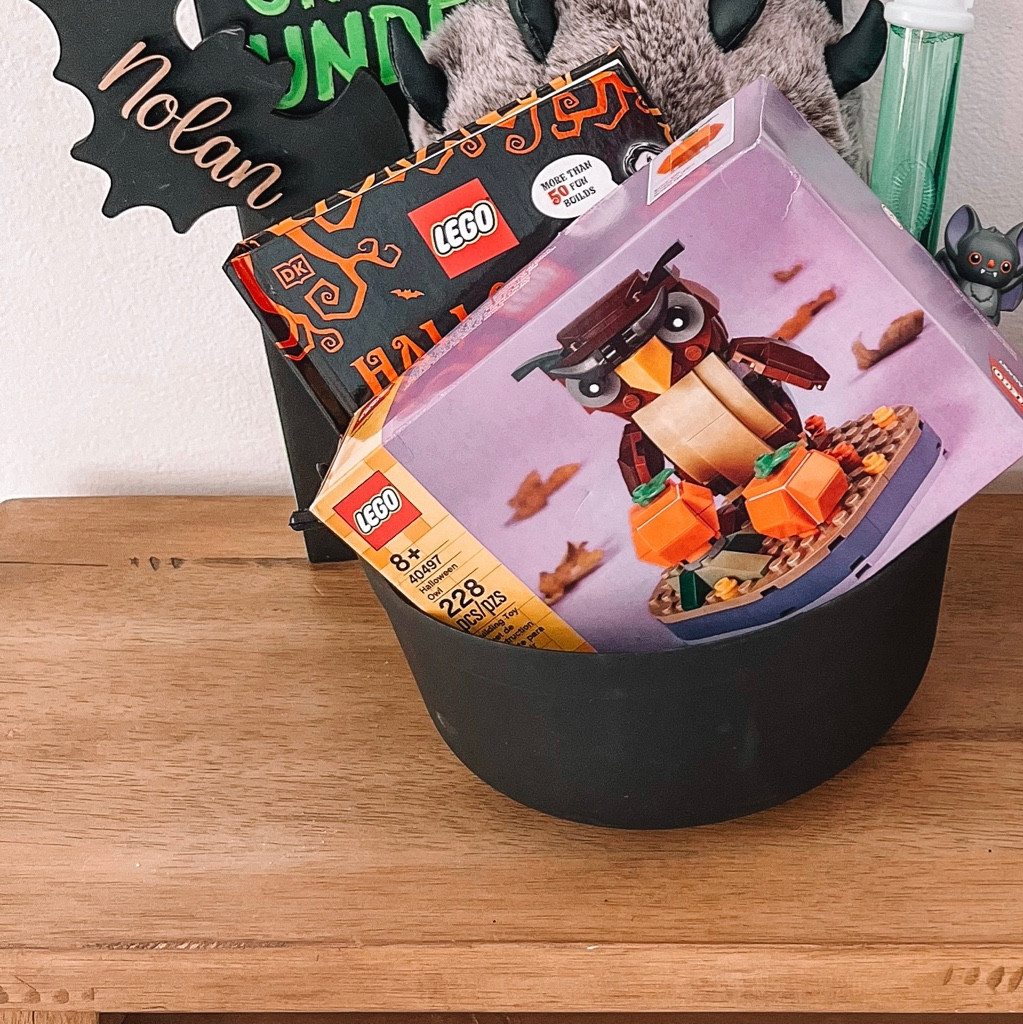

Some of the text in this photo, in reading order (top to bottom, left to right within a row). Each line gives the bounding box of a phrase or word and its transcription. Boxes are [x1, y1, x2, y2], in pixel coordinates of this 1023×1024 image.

[541, 160, 593, 191] MORE THAN
[548, 176, 588, 206] 50 FUN
[563, 186, 596, 207] BUILDS
[431, 200, 498, 257] LEGO
[280, 260, 308, 283] DK
[354, 487, 401, 534] LEGO
[389, 547, 421, 572] 8+
[408, 553, 442, 584] 40497
[418, 563, 459, 594] Halloween
[427, 587, 444, 601] Owl
[438, 578, 485, 619] 228
[456, 590, 507, 633] pcs/pzs
[502, 607, 520, 620] Toy
